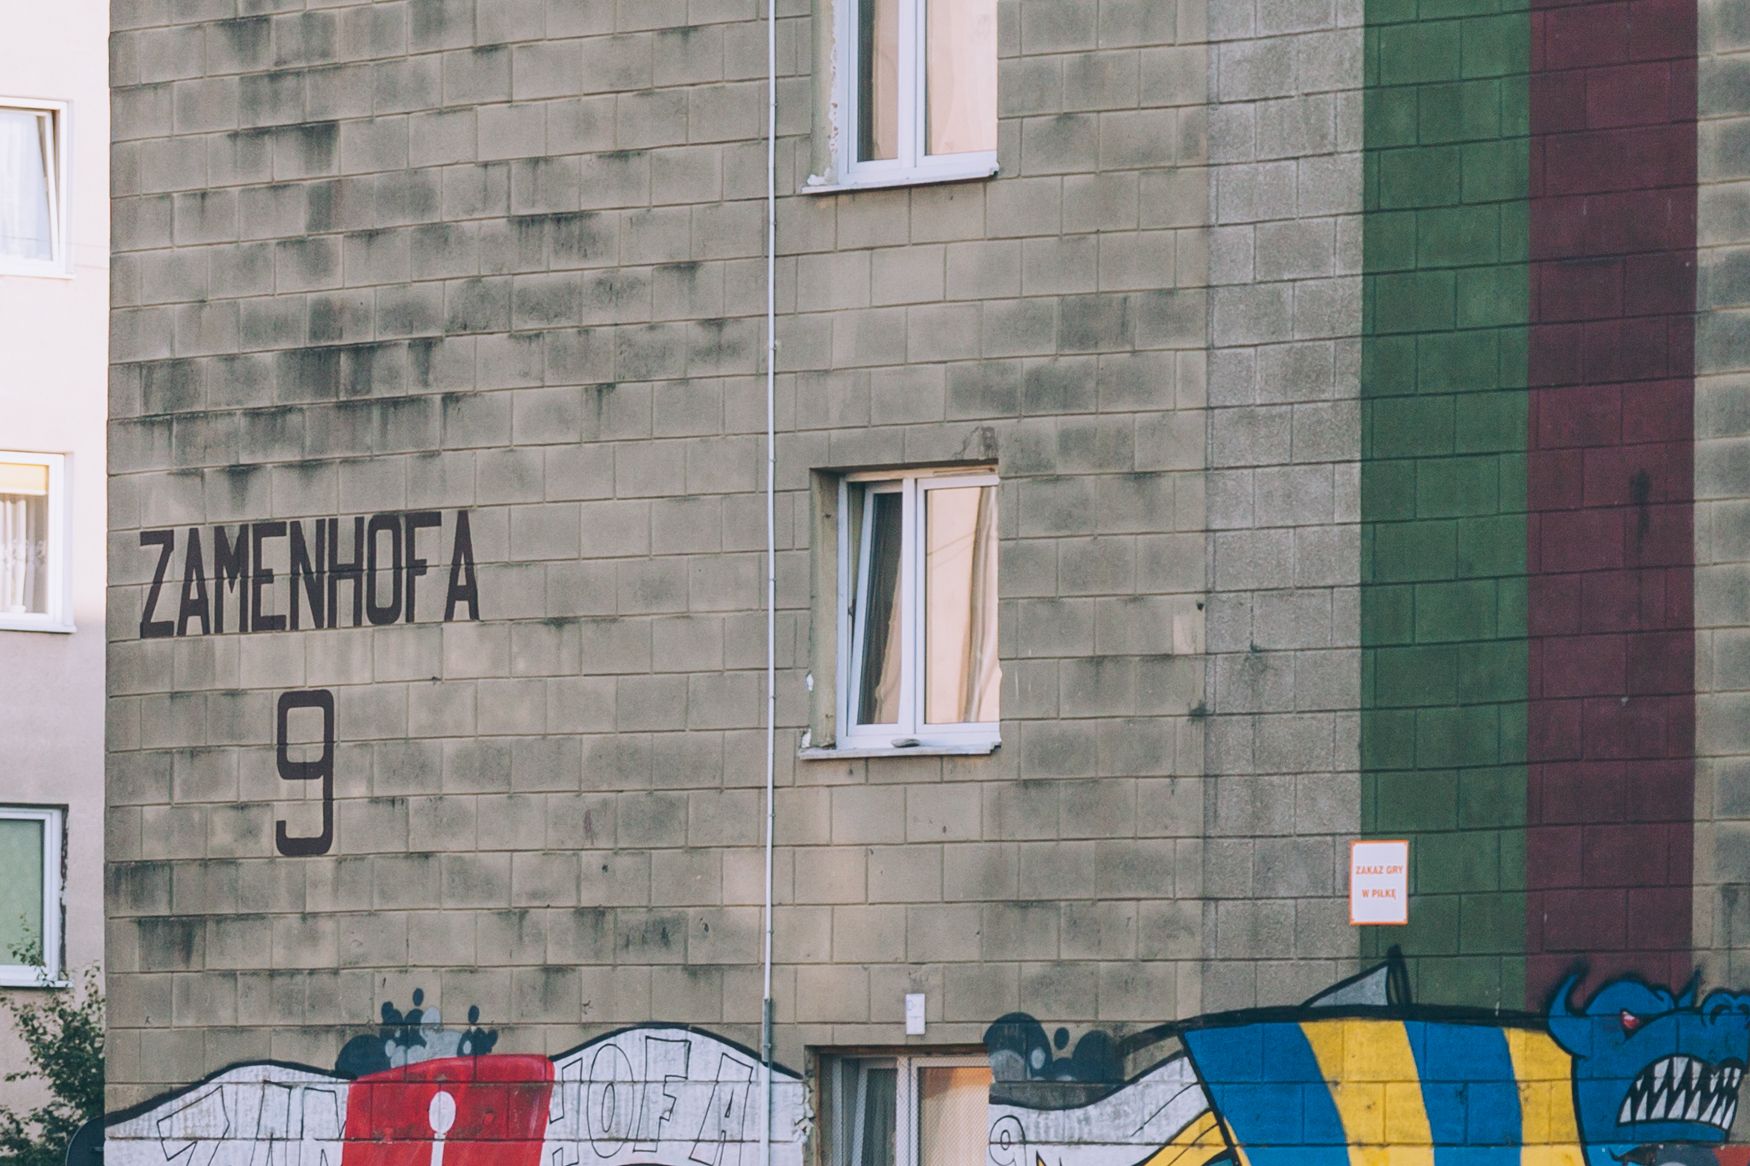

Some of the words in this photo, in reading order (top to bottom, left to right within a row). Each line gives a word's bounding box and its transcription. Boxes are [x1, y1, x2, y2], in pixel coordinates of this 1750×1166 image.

[139, 510, 480, 639] ZAMENHOFA
[275, 689, 334, 856] 9
[1356, 866, 1384, 874] ZAKAZ
[1386, 866, 1403, 874] GRY
[1362, 890, 1370, 898] W
